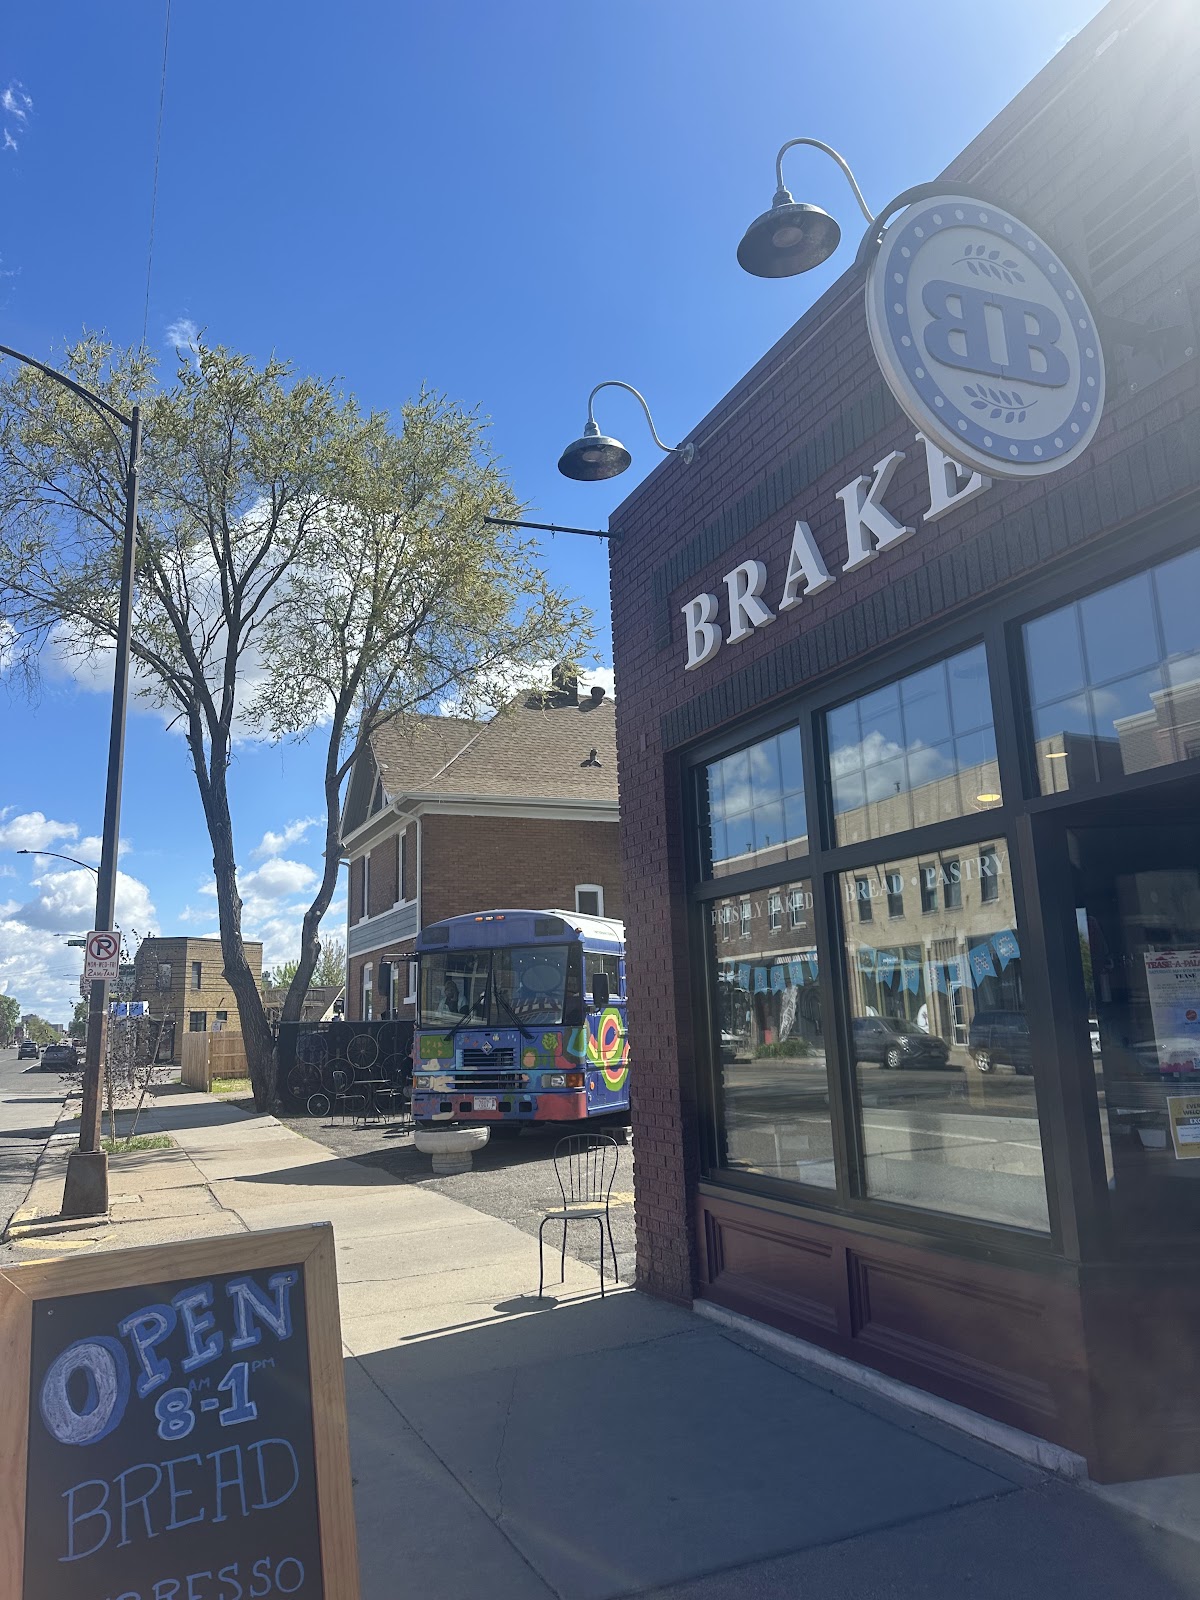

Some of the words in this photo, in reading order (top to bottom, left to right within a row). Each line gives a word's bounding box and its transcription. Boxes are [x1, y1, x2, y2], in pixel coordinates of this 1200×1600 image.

[681, 431, 992, 671] BRAKE
[711, 900, 764, 926] FRESHLY
[766, 891, 814, 916] BAKED
[844, 873, 905, 903] BREAD
[925, 851, 1007, 889] PASTRY
[39, 1270, 298, 1447] OPEN
[57, 1437, 299, 1562] BREAD
[105, 1556, 304, 1600] RESSO
